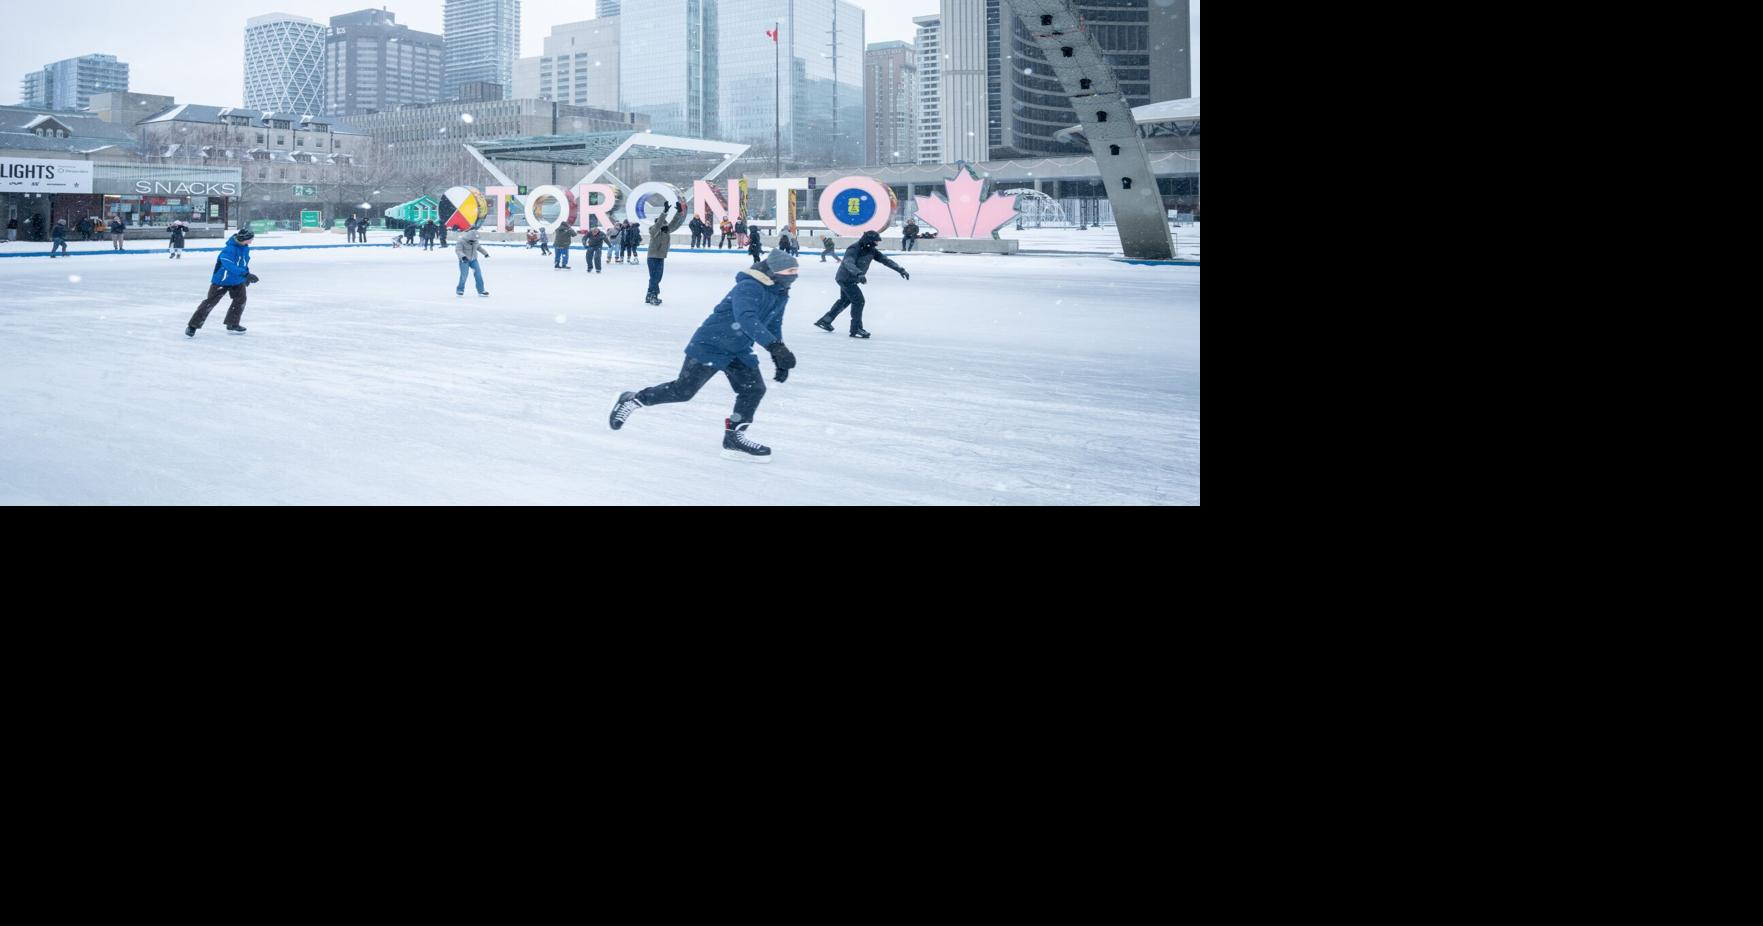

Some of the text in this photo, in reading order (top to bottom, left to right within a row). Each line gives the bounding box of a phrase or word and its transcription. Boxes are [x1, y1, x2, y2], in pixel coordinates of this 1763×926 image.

[0, 163, 55, 179] LIGHTS
[135, 180, 236, 195] SNACKS
[484, 175, 894, 238] TORONTO
